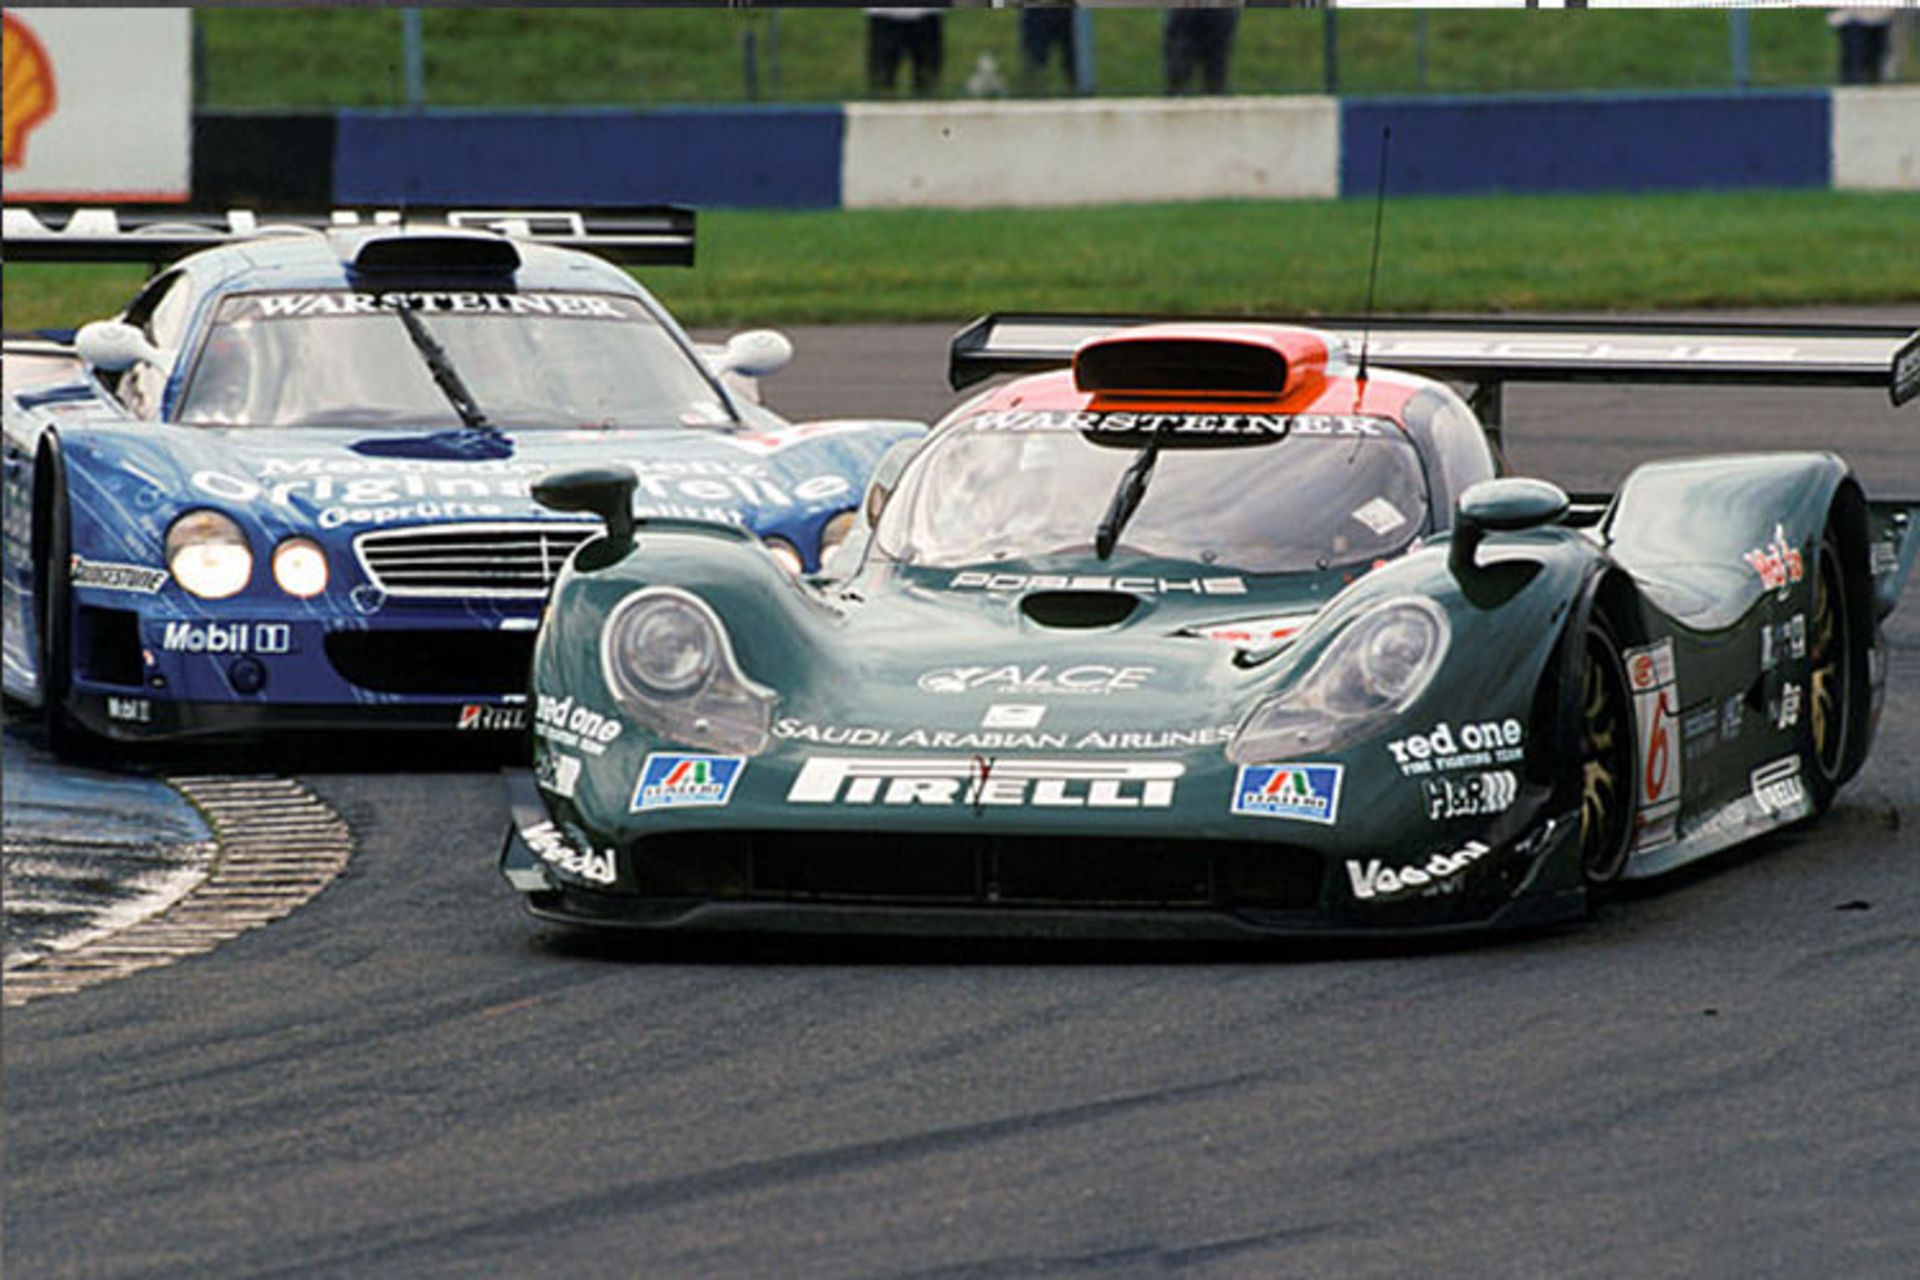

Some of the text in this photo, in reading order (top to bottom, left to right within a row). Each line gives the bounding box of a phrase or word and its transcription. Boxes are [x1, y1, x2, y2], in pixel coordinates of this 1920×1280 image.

[258, 292, 627, 318] WARSTEINER
[974, 411, 1381, 437] WARSTEINER
[950, 572, 1249, 596] PORSCHE
[163, 620, 249, 652] Mobil
[570, 706, 623, 742] one
[770, 717, 1239, 750] SAUDI ARABIAN AIRLINES
[1387, 723, 1457, 763] red
[1461, 718, 1522, 751] one
[1644, 690, 1669, 801] 6
[787, 757, 1187, 807] PIRELLI
